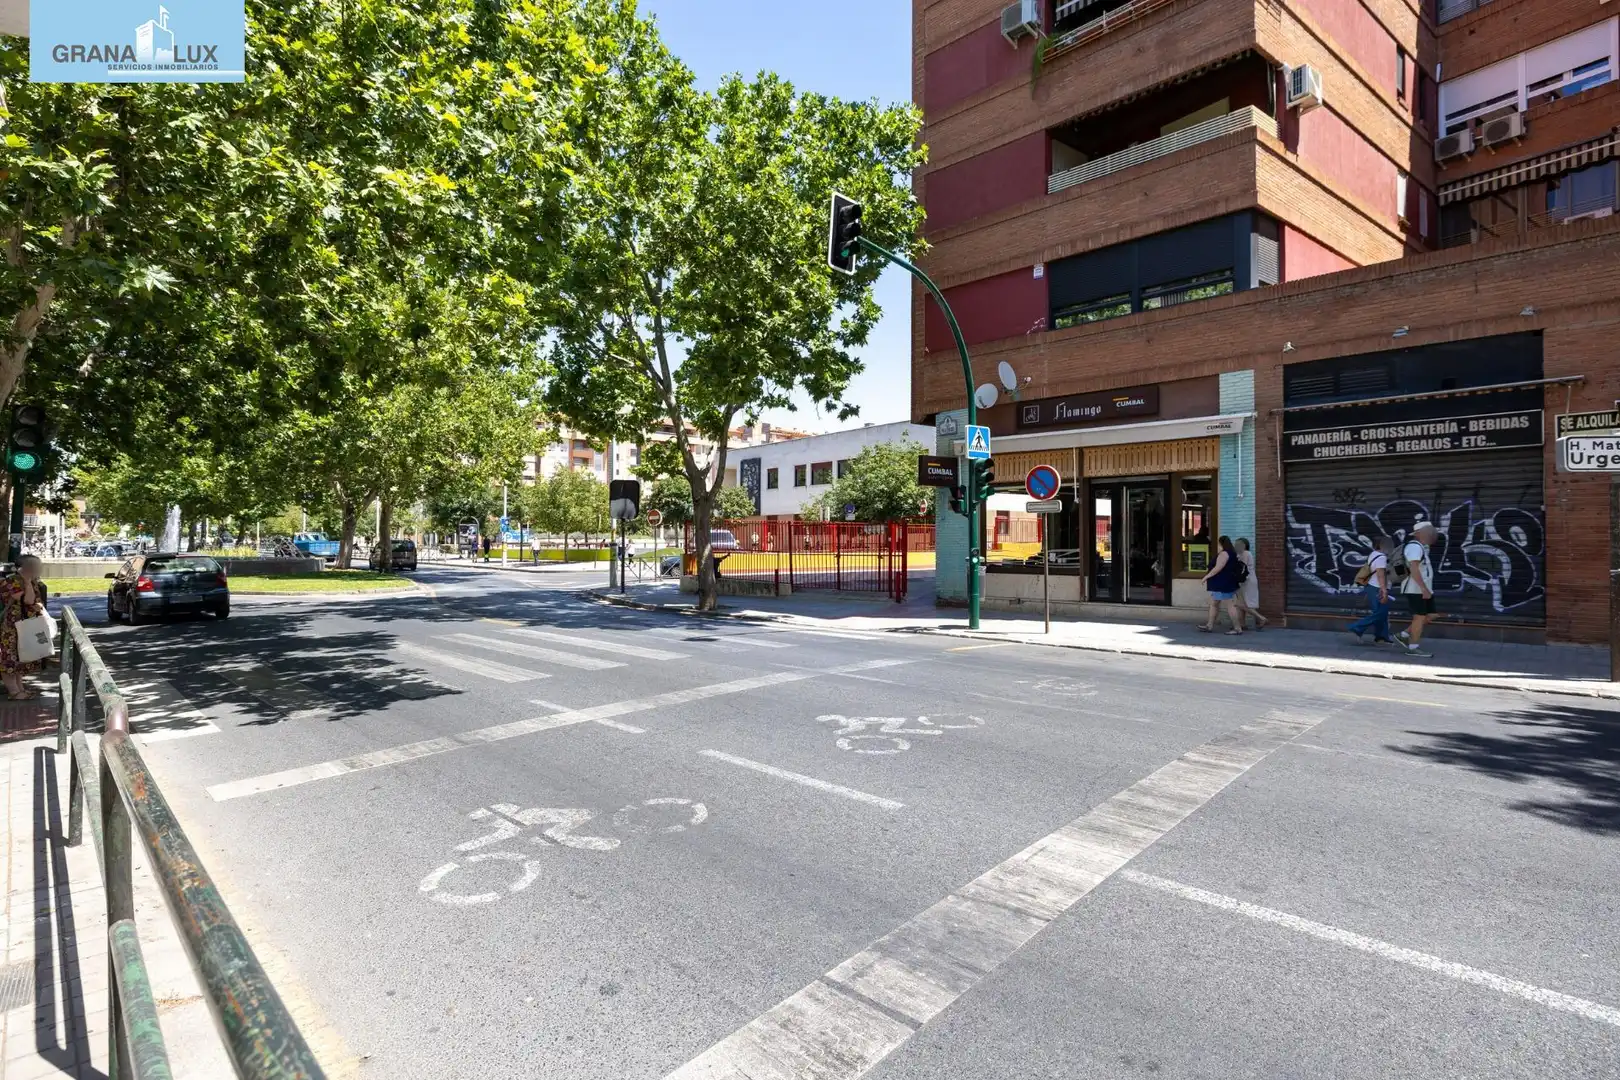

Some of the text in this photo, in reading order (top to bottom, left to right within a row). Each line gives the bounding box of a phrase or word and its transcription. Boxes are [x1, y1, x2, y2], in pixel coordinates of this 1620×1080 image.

[1116, 398, 1145, 408] CUMBAL
[1053, 401, 1102, 421] Flamingo
[1560, 417, 1574, 430] SE
[1291, 429, 1352, 446] PANADERÍA
[1361, 421, 1459, 441] CROISSANTERÍA
[1469, 416, 1530, 432] BEBIDAS
[1313, 441, 1387, 458] CHUCHERÍAS
[1395, 437, 1452, 452] REGALOS
[1462, 434, 1497, 448] ETC...
[1570, 441, 1587, 451] H.
[1570, 452, 1620, 468] Urge
[927, 467, 954, 476] CUMBAL
